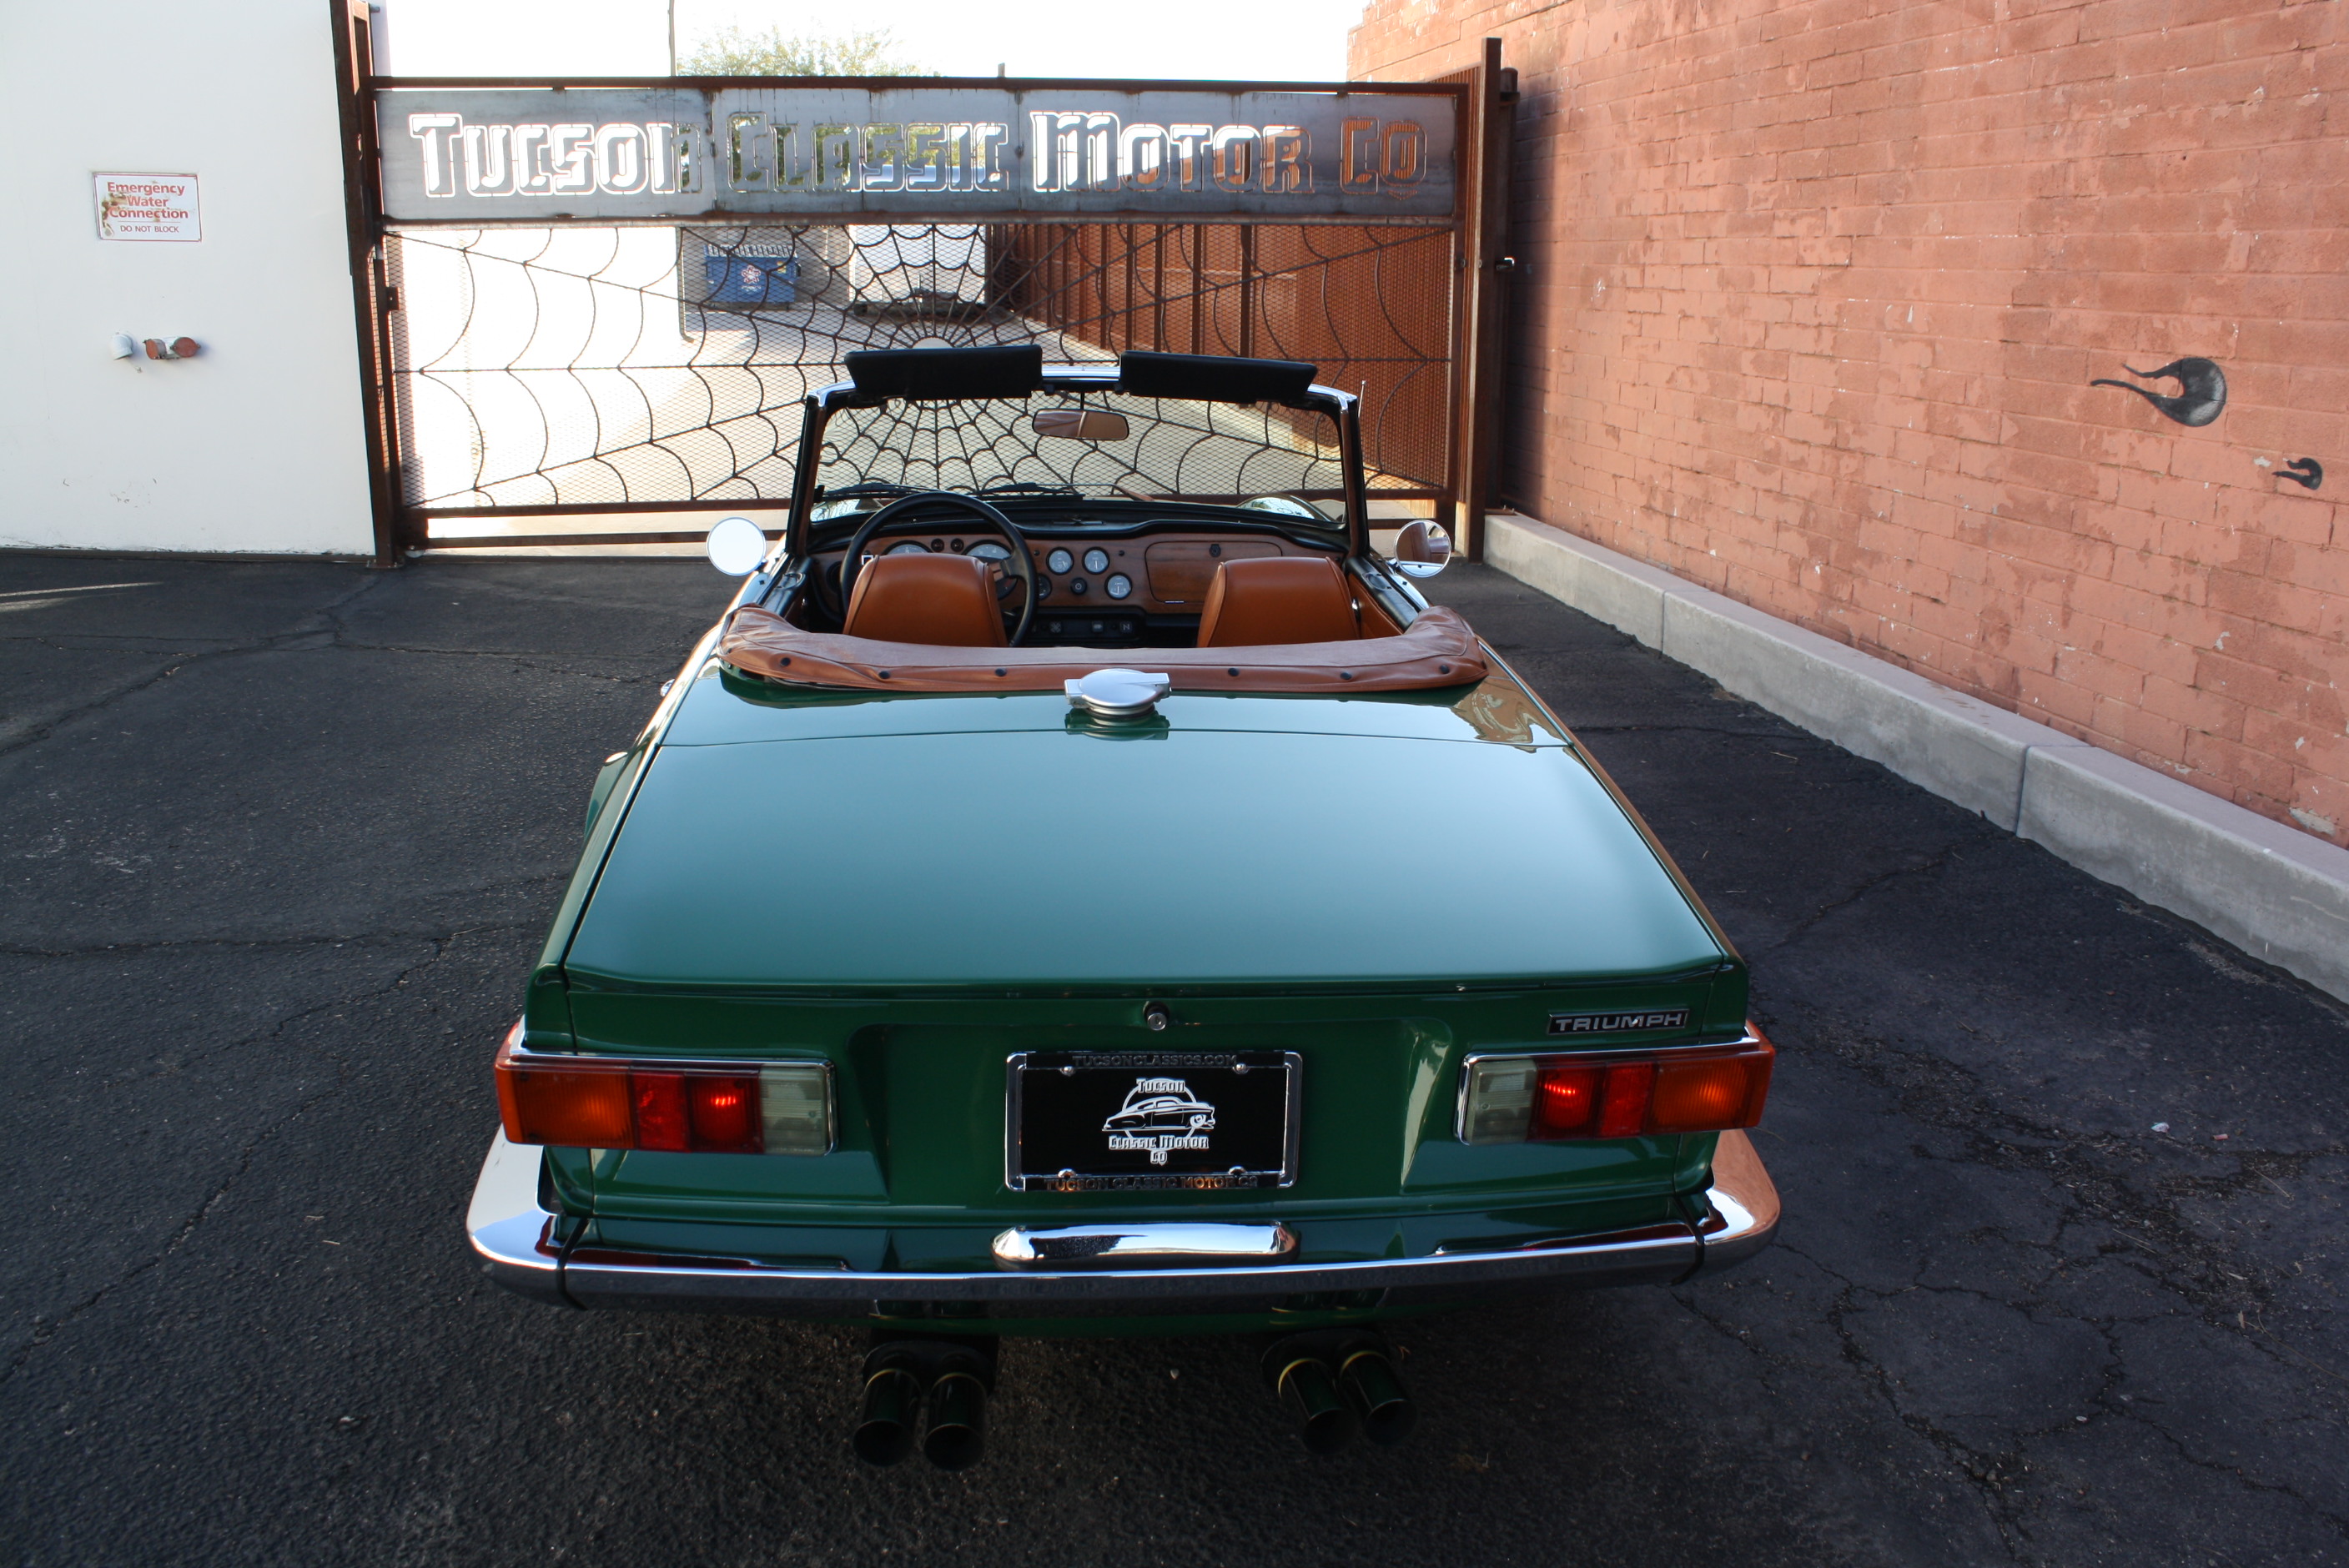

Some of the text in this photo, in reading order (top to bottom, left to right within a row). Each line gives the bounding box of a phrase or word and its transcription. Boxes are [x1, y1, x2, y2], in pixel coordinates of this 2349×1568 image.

[107, 182, 185, 196] Emergency
[127, 196, 169, 207] Water
[108, 207, 189, 219] Connection
[1556, 1013, 1682, 1031] TRIUMPH
[1072, 1054, 1237, 1067] TUCSONCLASSICS.COM
[1044, 1179, 1109, 1191] TUCSON
[1112, 1178, 1176, 1189] CLASSIC
[1180, 1177, 1235, 1189] MOTOR
